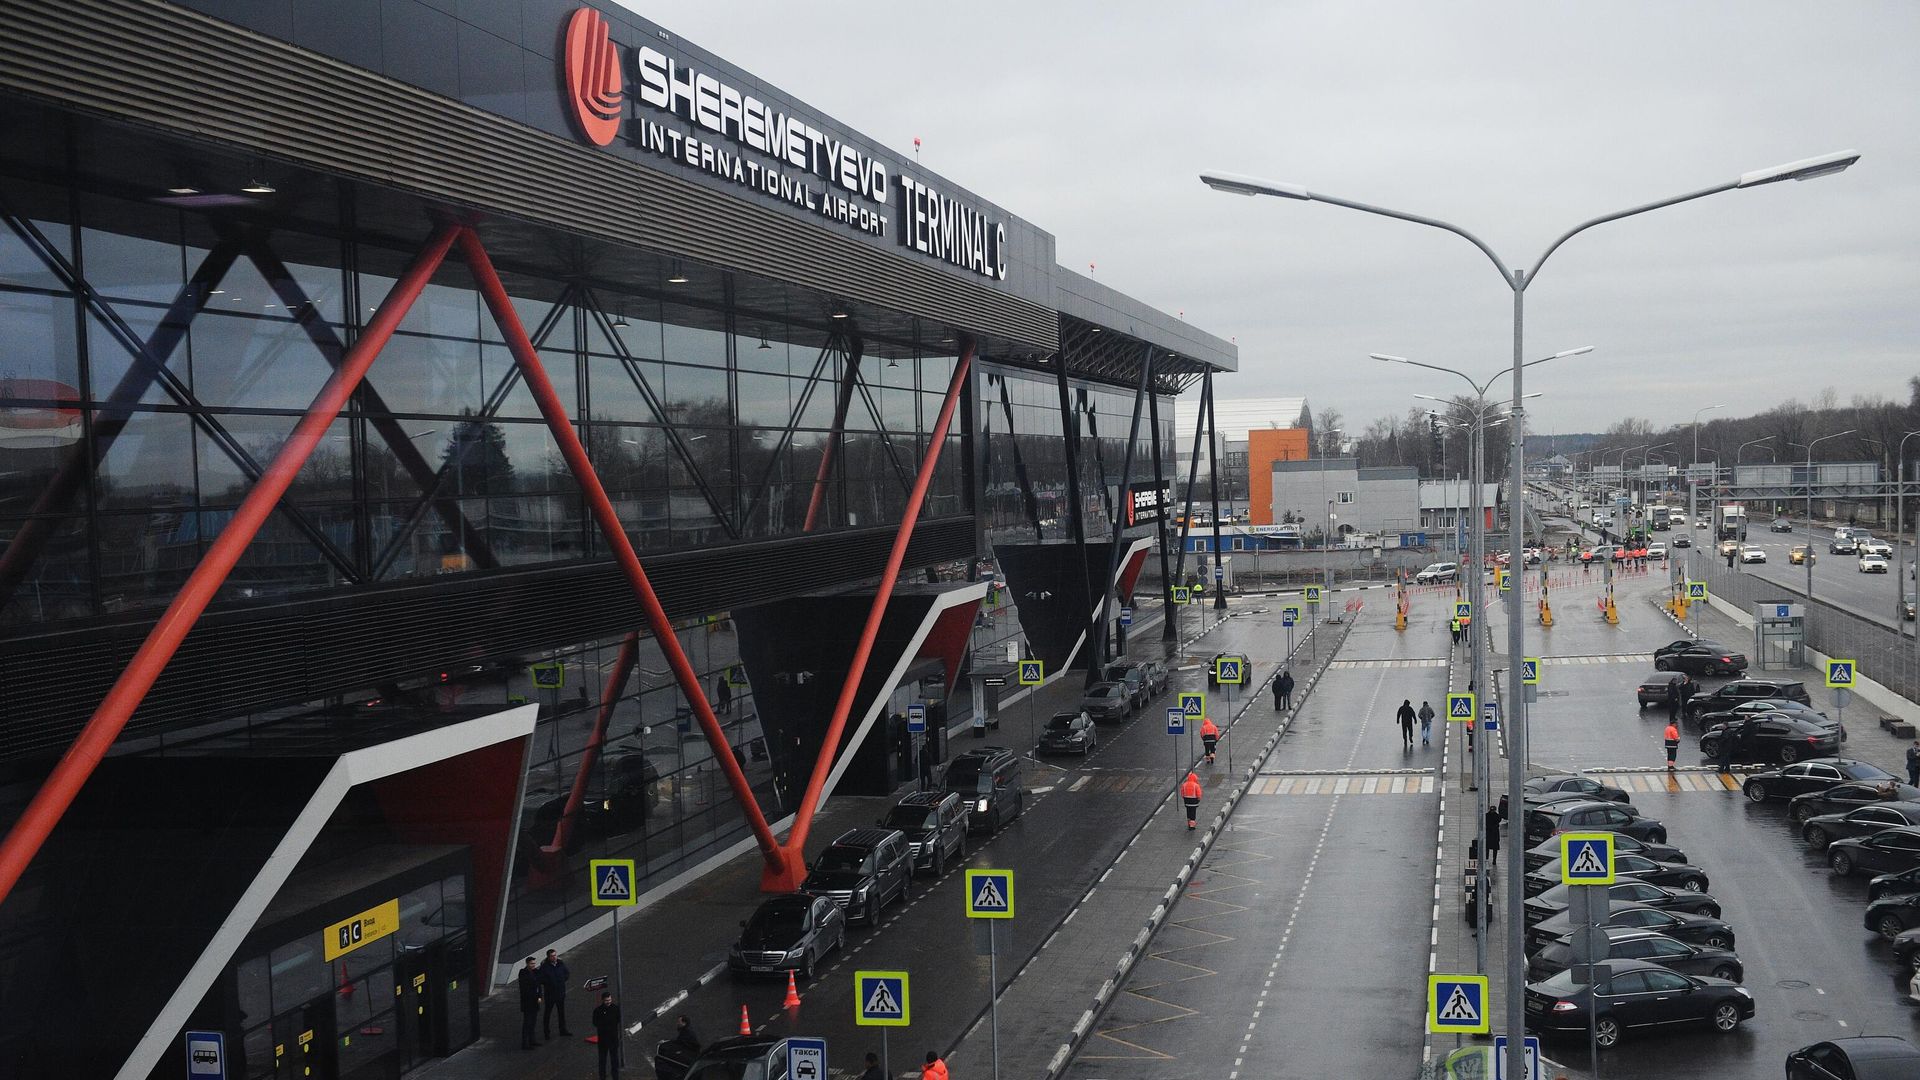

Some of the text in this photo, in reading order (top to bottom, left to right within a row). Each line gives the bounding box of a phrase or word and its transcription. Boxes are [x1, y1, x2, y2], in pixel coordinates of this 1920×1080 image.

[639, 46, 887, 203] SHEREMETYEVO
[640, 118, 888, 237] INTERNATIONAL AIRPORT
[902, 175, 1006, 280] TERMINAL C
